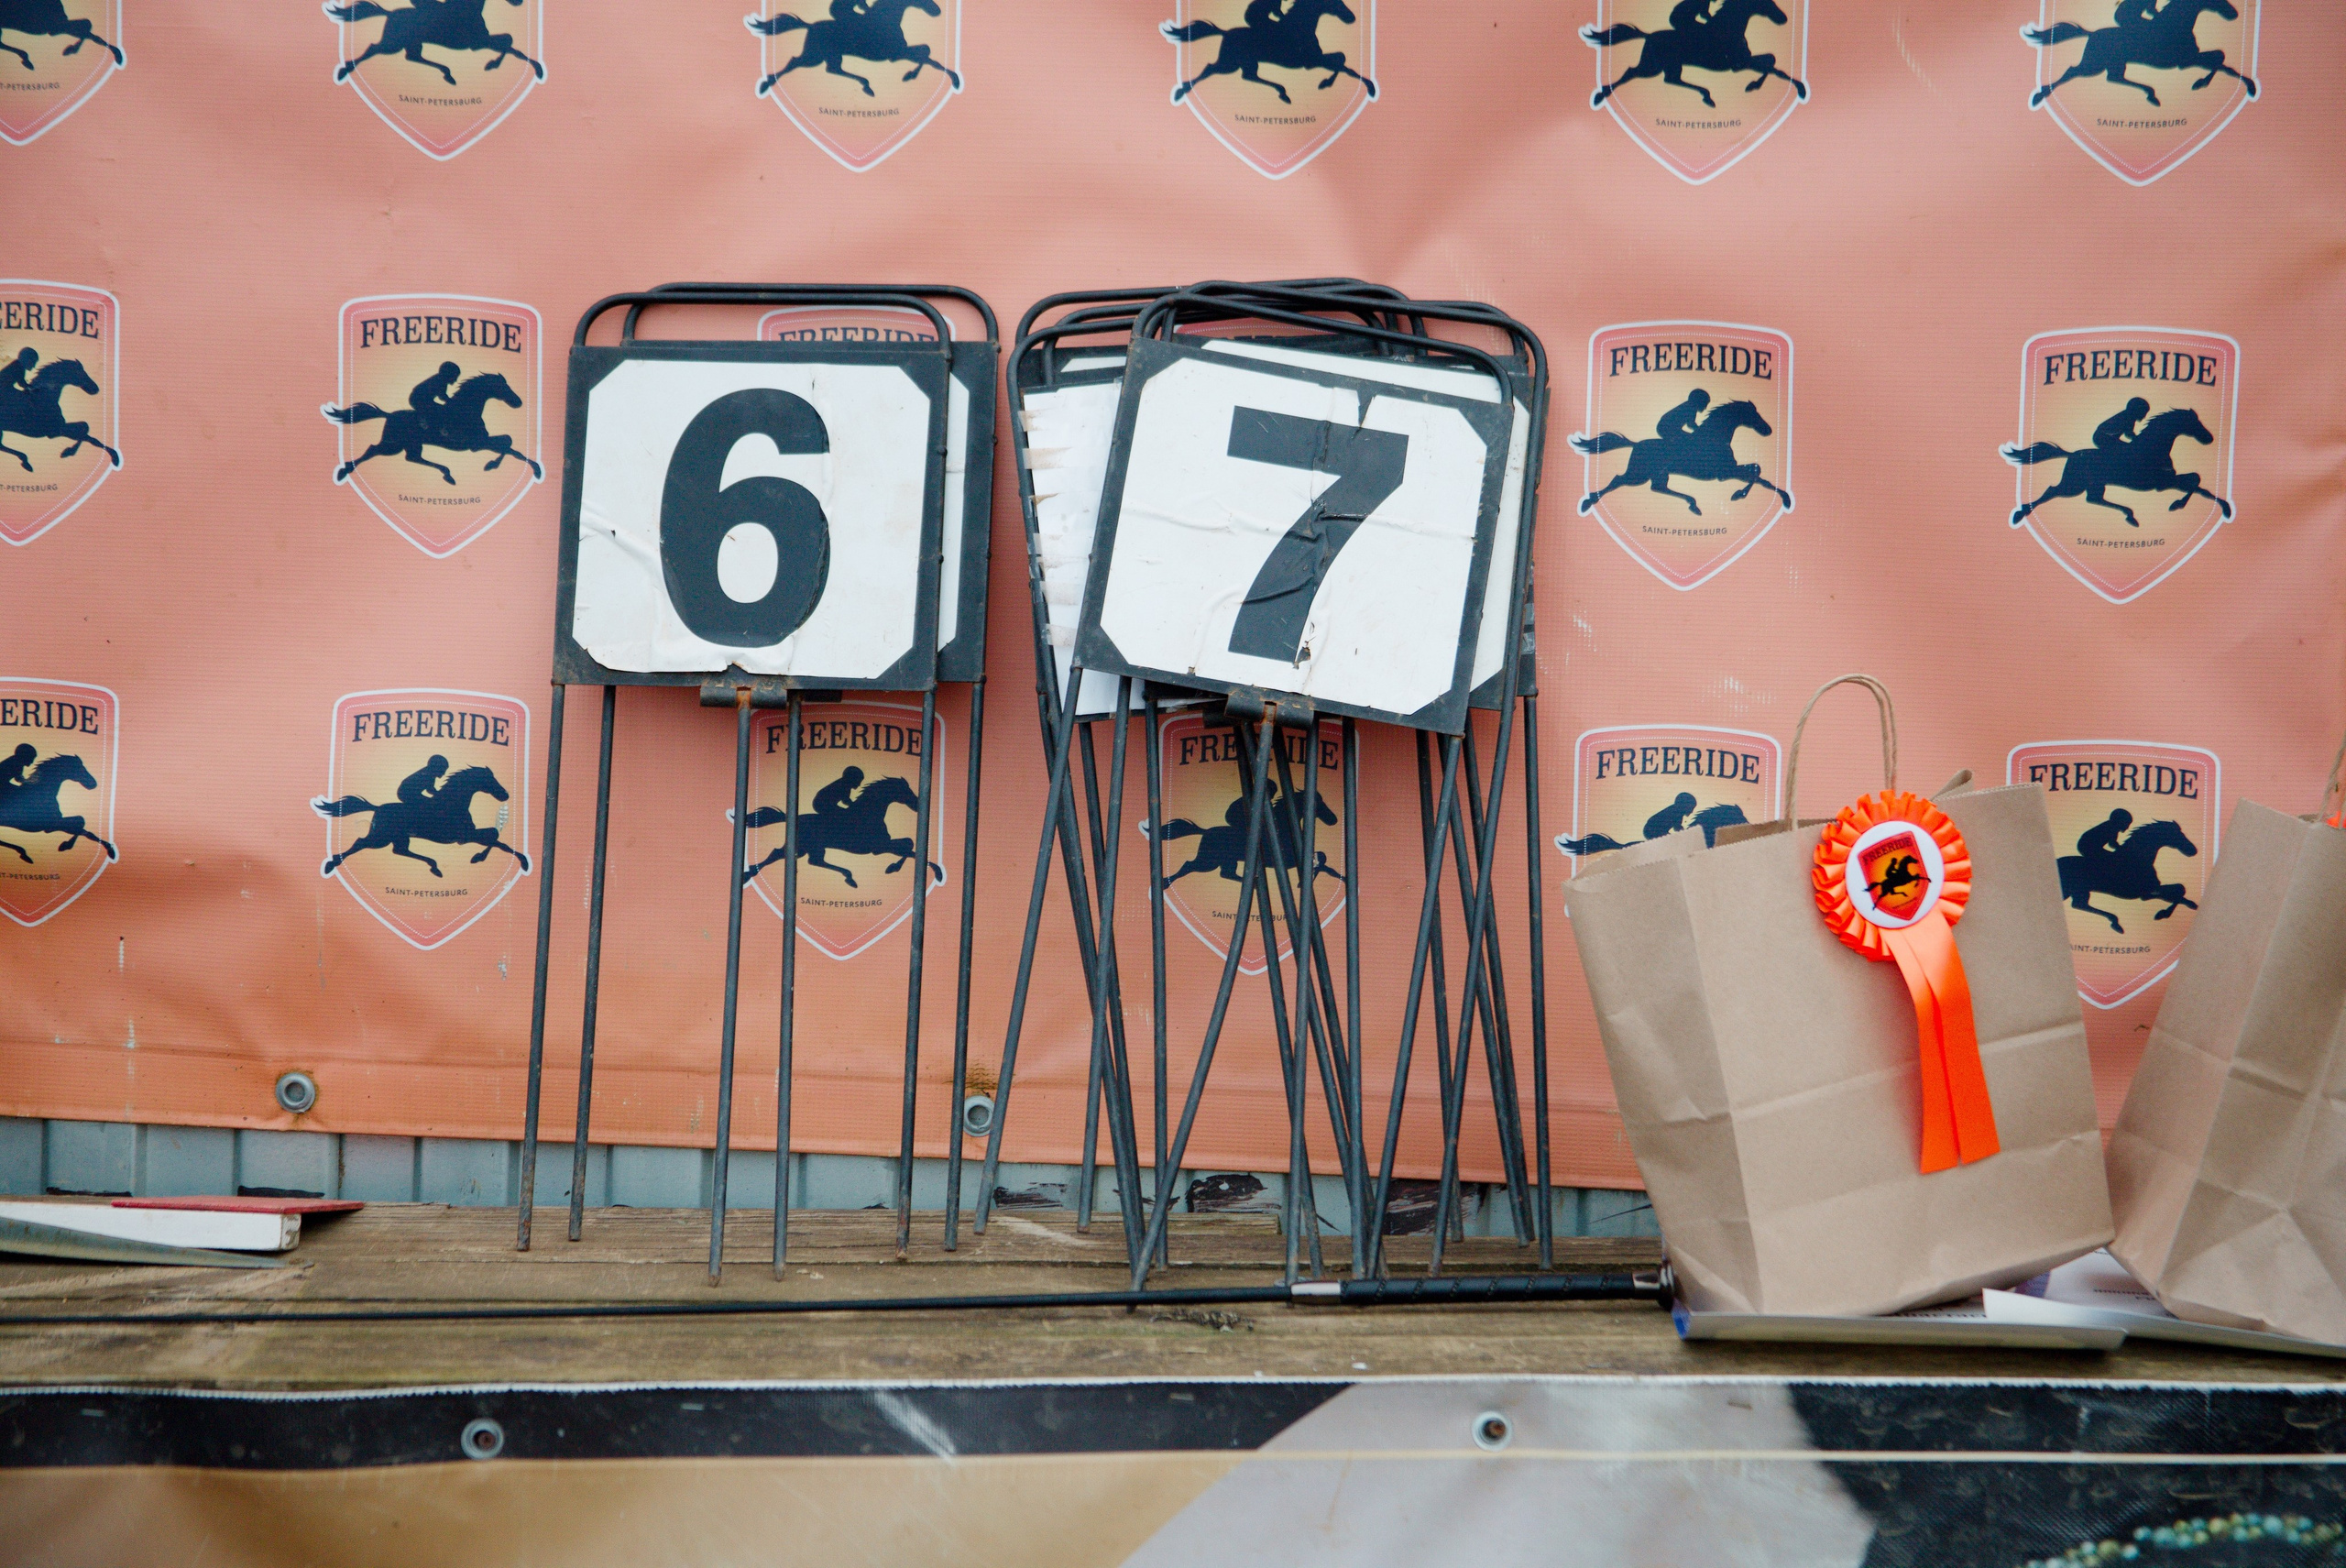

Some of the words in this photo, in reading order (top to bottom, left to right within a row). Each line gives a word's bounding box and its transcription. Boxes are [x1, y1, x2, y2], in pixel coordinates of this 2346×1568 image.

[399, 94, 482, 105] SAINT-PETERSBURG
[818, 107, 900, 117] SAINT-PETERSBURG
[1234, 115, 1317, 125] SAINT-PETERSBURG
[1655, 118, 1742, 129] SAINT-PETERSBURG
[2097, 117, 2187, 129] SAINT-PETERSBURG
[0, 302, 99, 339] ERIDE
[360, 315, 521, 354] FREERIDE
[1609, 343, 1772, 379] FREERIDE
[2044, 349, 2218, 388] FREERIDE
[398, 493, 481, 505] SAINT-PETERSBURG
[659, 388, 830, 648] 6
[1227, 405, 1409, 663] 7
[1642, 525, 1727, 537] SAINT-PETERSBURG
[2077, 537, 2165, 549] SAINT-PETERSBURG
[352, 709, 510, 747] FREERIDE
[1179, 733, 1339, 771] FREIE
[1595, 746, 1760, 784] FREERIDE
[2029, 762, 2198, 800] FREERIDE
[0, 872, 60, 881] T-PETERSBURG
[385, 886, 468, 897] SAINT-PETERSBURG
[800, 897, 882, 908] SAINT-PETERSBURG
